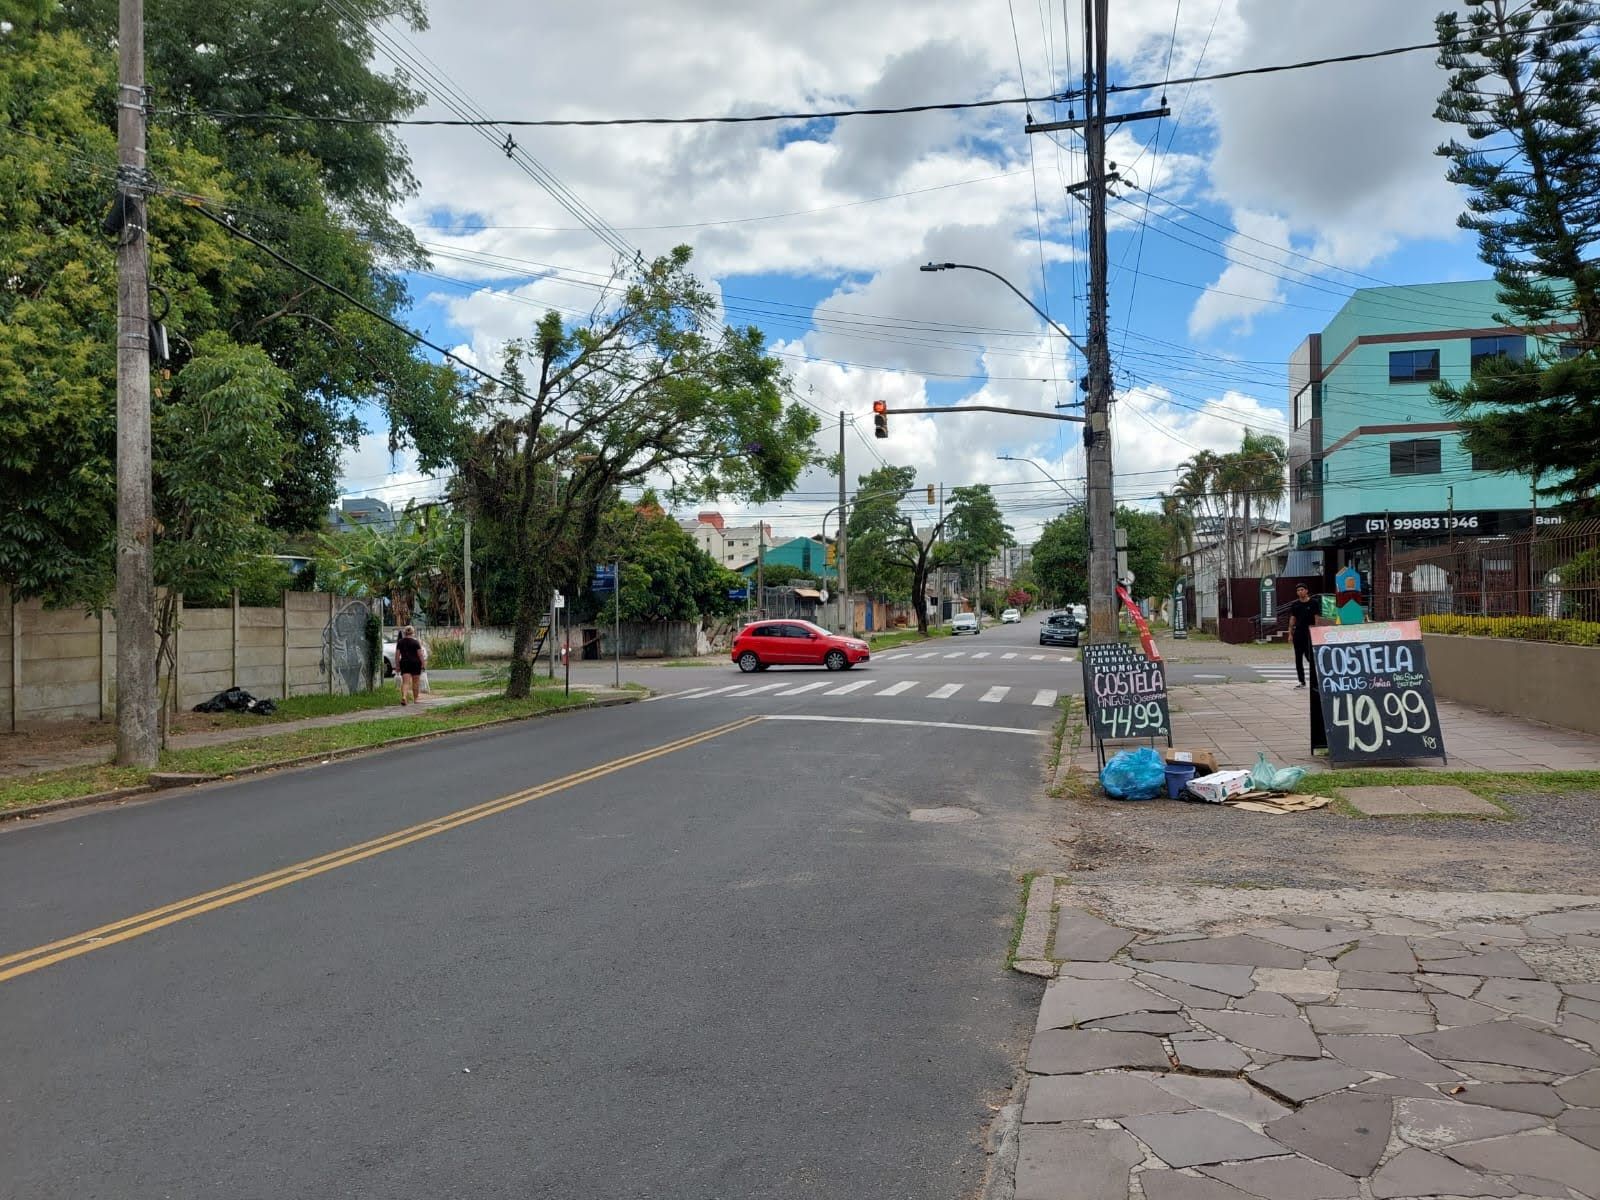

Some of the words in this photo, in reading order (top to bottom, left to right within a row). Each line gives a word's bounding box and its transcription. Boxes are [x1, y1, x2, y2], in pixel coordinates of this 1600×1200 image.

[1365, 519, 1389, 533] (51)
[1393, 517, 1440, 530] 99883
[1443, 516, 1478, 529] 1946
[1090, 655, 1144, 664] PROMOÇÃO
[1094, 661, 1158, 673] PROMOÇÃO
[1318, 644, 1414, 676] COSTELA
[1094, 670, 1163, 697] COSTELA
[1322, 677, 1367, 692] ANGUS
[1097, 695, 1131, 708] ANGUS
[1101, 701, 1163, 738] 44.99
[1333, 689, 1431, 752] 49.99
